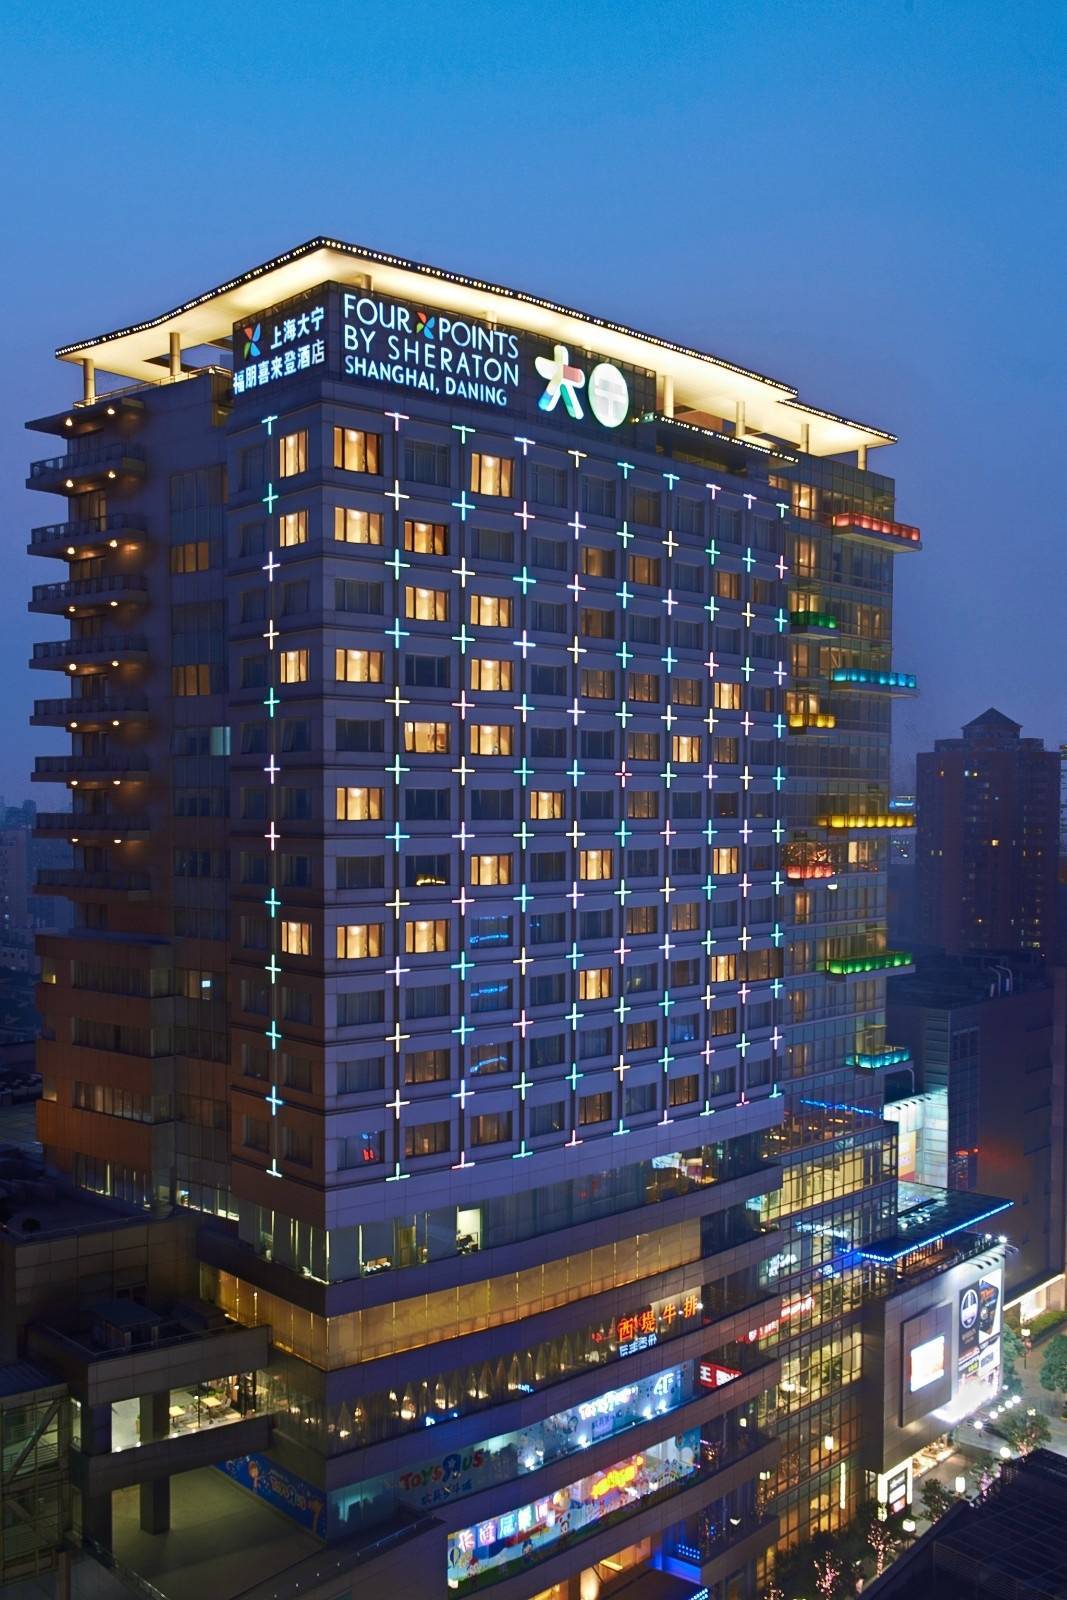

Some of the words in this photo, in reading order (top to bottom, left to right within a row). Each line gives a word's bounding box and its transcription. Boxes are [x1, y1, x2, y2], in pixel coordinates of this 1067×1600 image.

[270, 306, 324, 350] 上海大宁
[343, 293, 412, 333] FOUR
[438, 317, 519, 359] POINTS
[233, 338, 325, 395] 福朋喜来登酒店
[344, 324, 376, 353] BY
[388, 335, 519, 387] SHERATON
[345, 355, 440, 394] SHANGHAI,
[445, 376, 507, 406] DANING
